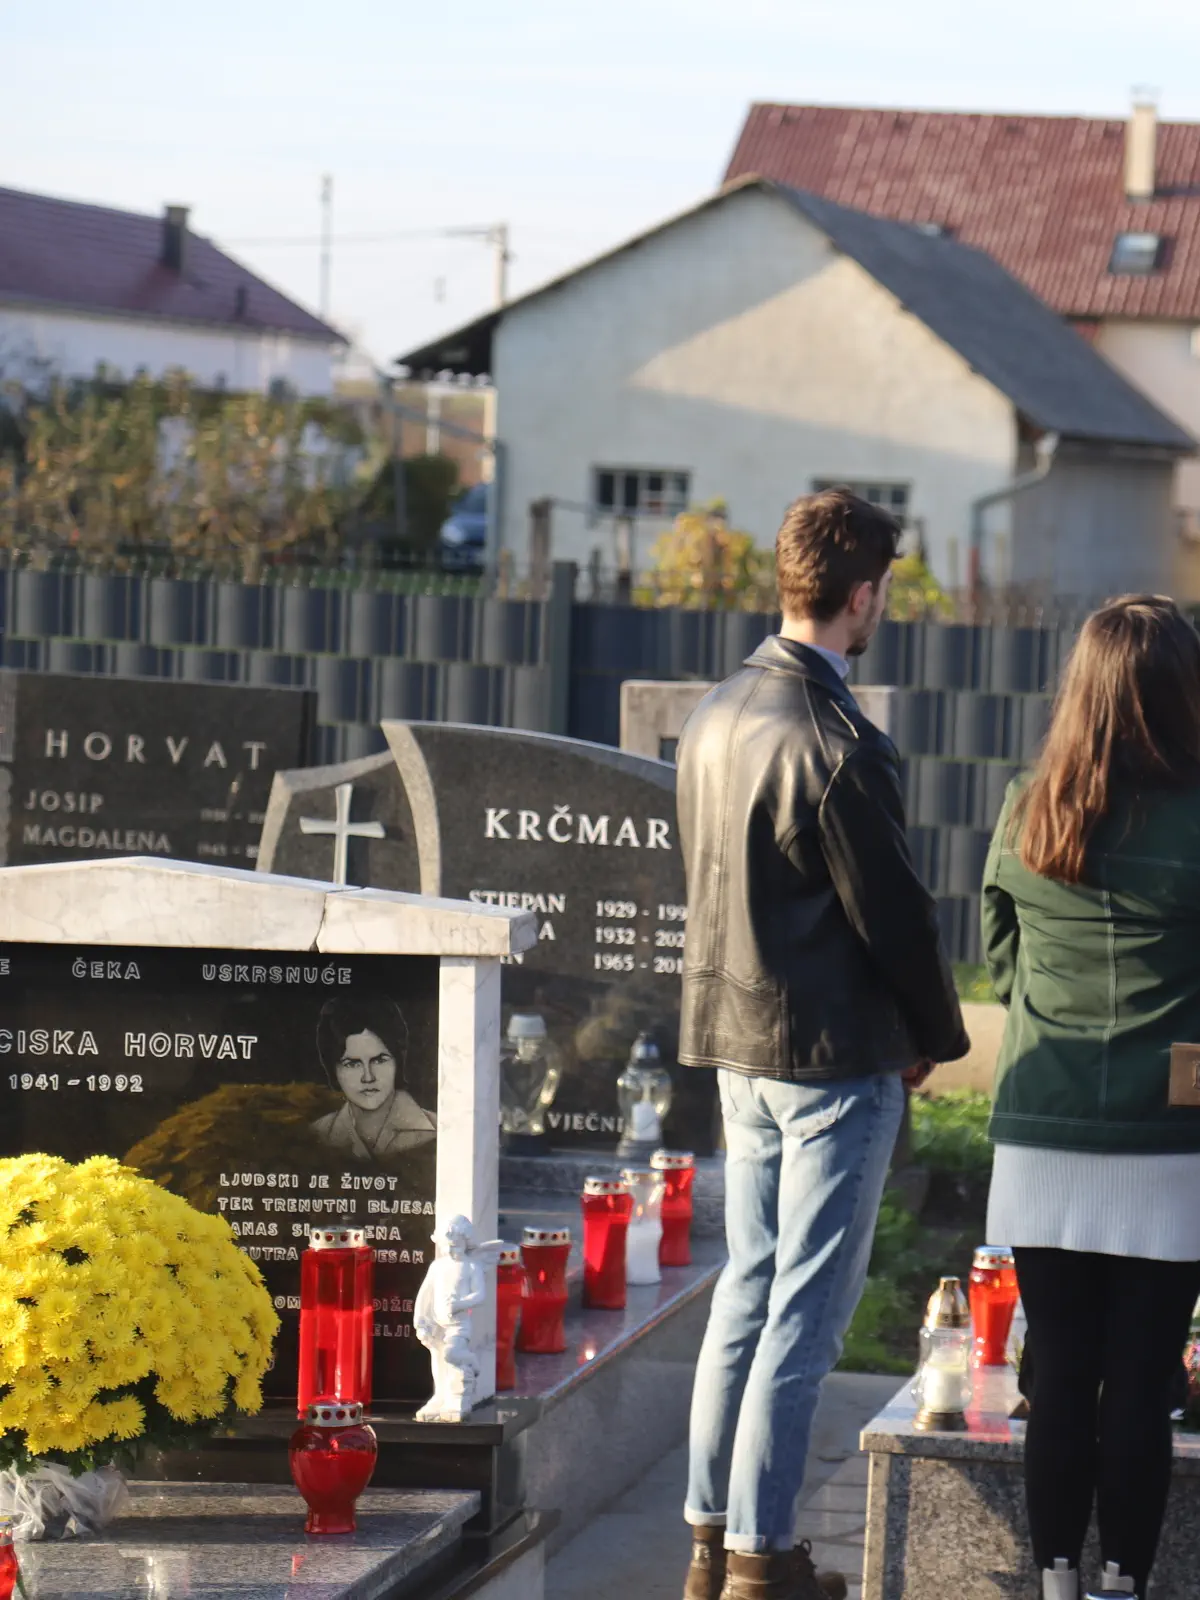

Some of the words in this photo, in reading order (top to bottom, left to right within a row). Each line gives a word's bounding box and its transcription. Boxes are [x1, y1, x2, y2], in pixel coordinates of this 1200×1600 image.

[44, 729, 267, 770] HORVAT
[24, 789, 104, 814] JOSIP
[484, 804, 672, 849] KRČMAR
[23, 824, 172, 853] MAGDALENA
[596, 901, 637, 919] 1929
[658, 904, 688, 921] 199
[595, 927, 636, 945] 1932
[655, 929, 685, 947] 202
[72, 957, 140, 979] ČEKA
[202, 962, 352, 985] USKRSNUĆE
[594, 953, 635, 971] 1965
[654, 956, 683, 974] 201
[124, 1032, 258, 1060] HORVAT
[219, 1173, 299, 1188] LJUDSKI
[309, 1175, 329, 1189] JE
[341, 1173, 398, 1190] ŽIVOT
[218, 1197, 253, 1211] TEK
[262, 1198, 356, 1213] TRENUTNI
[368, 1200, 437, 1215] BLJESA
[231, 1222, 278, 1237] ANAS
